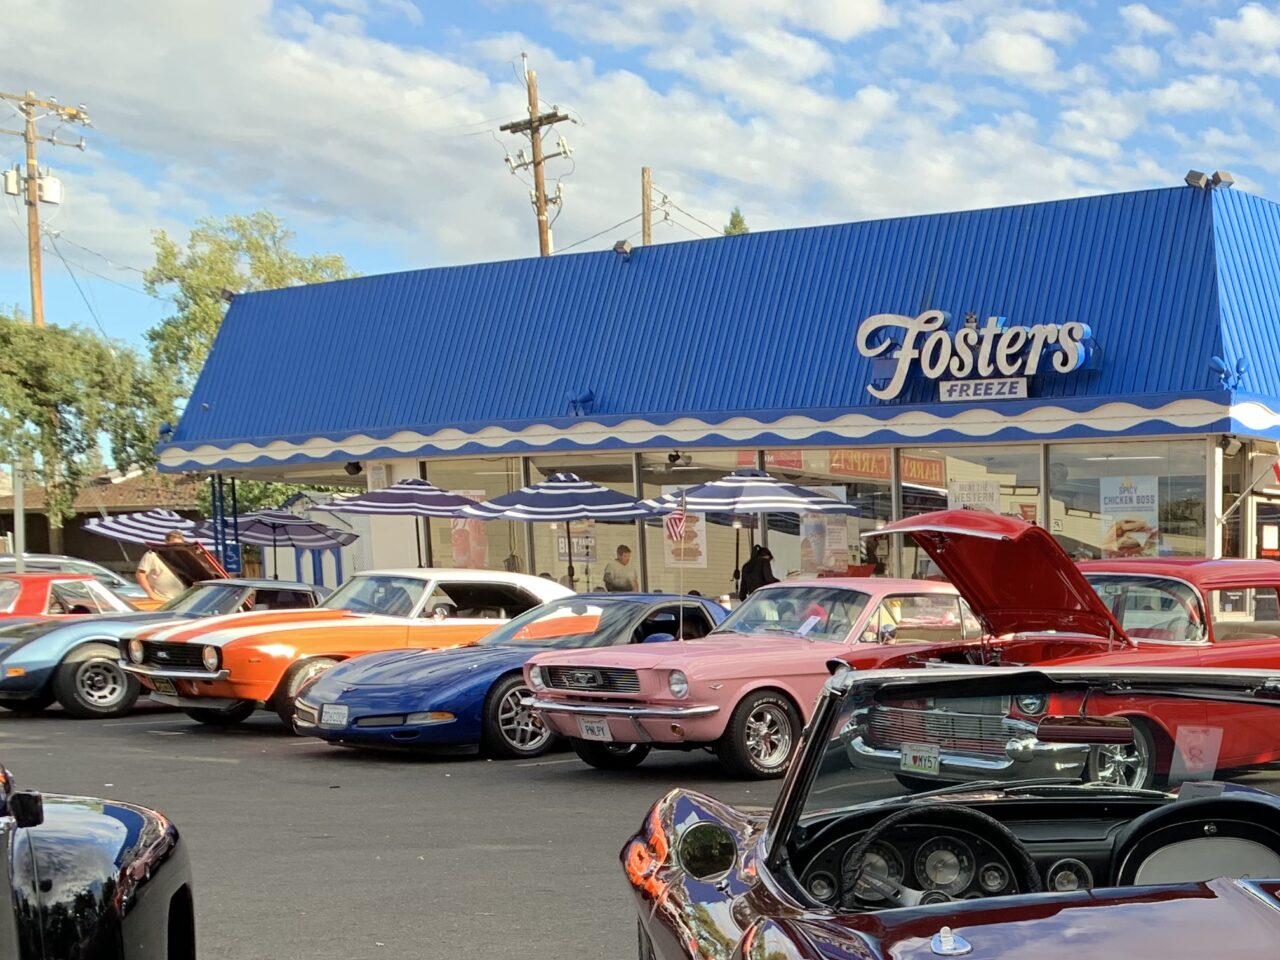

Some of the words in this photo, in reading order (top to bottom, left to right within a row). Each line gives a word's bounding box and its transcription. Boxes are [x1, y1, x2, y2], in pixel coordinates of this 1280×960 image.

[856, 309, 1090, 401] Fosters
[946, 380, 1020, 398] FREEZE
[954, 492, 994, 503] WESTERN
[1103, 495, 1134, 505] CHICKEN
[1135, 494, 1155, 505] BOSS
